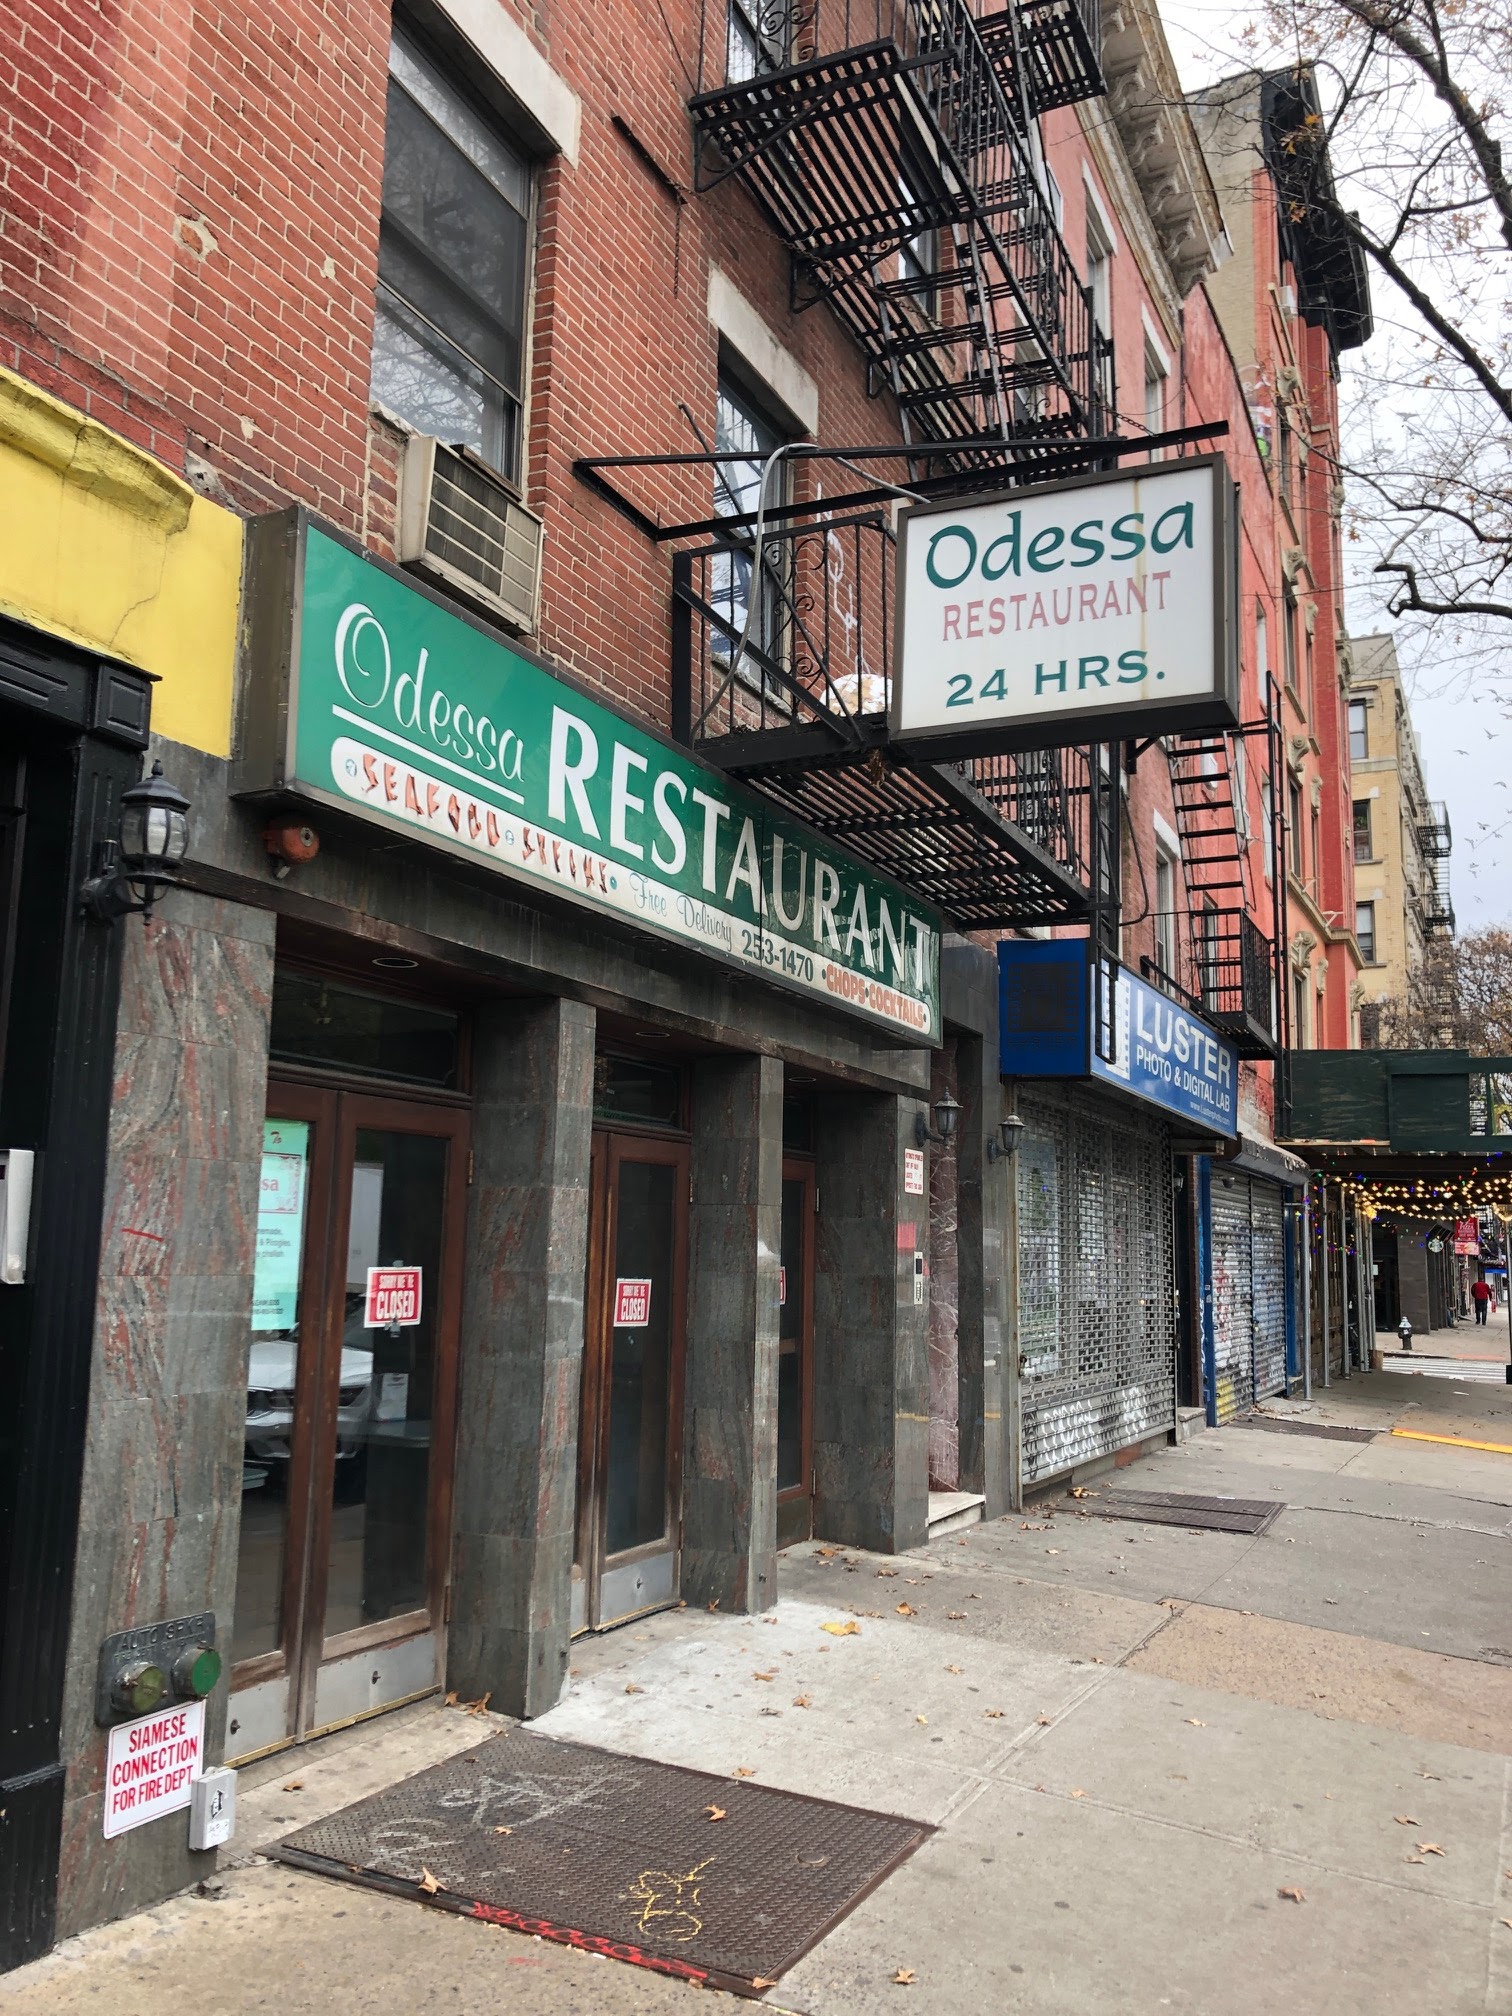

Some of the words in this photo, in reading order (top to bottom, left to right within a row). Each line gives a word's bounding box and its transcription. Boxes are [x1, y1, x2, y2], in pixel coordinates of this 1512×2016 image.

[926, 501, 1194, 589] Odessa
[943, 570, 1171, 641] RESTAURANT
[335, 603, 525, 782] Odessa
[946, 669, 1008, 708] 24
[1034, 650, 1165, 695] HRS.
[547, 704, 931, 991] RESTAURANT
[629, 872, 668, 918] Free
[676, 895, 733, 952] Delivery
[741, 929, 814, 982] 253-1470
[1137, 989, 1231, 1089] LUSTER
[1136, 1044, 1172, 1082] PHOTO
[1173, 1066, 1181, 1087] &
[1183, 1070, 1215, 1105] DIGITAL
[1215, 1089, 1230, 1113] LAB
[376, 1290, 415, 1319] CLOSED
[621, 1298, 645, 1320] CLOSED
[113, 1736, 198, 1787] CONNECTION
[129, 1713, 186, 1753] SIAMESE
[113, 1787, 136, 1814] FOR
[139, 1776, 163, 1804] FIRE
